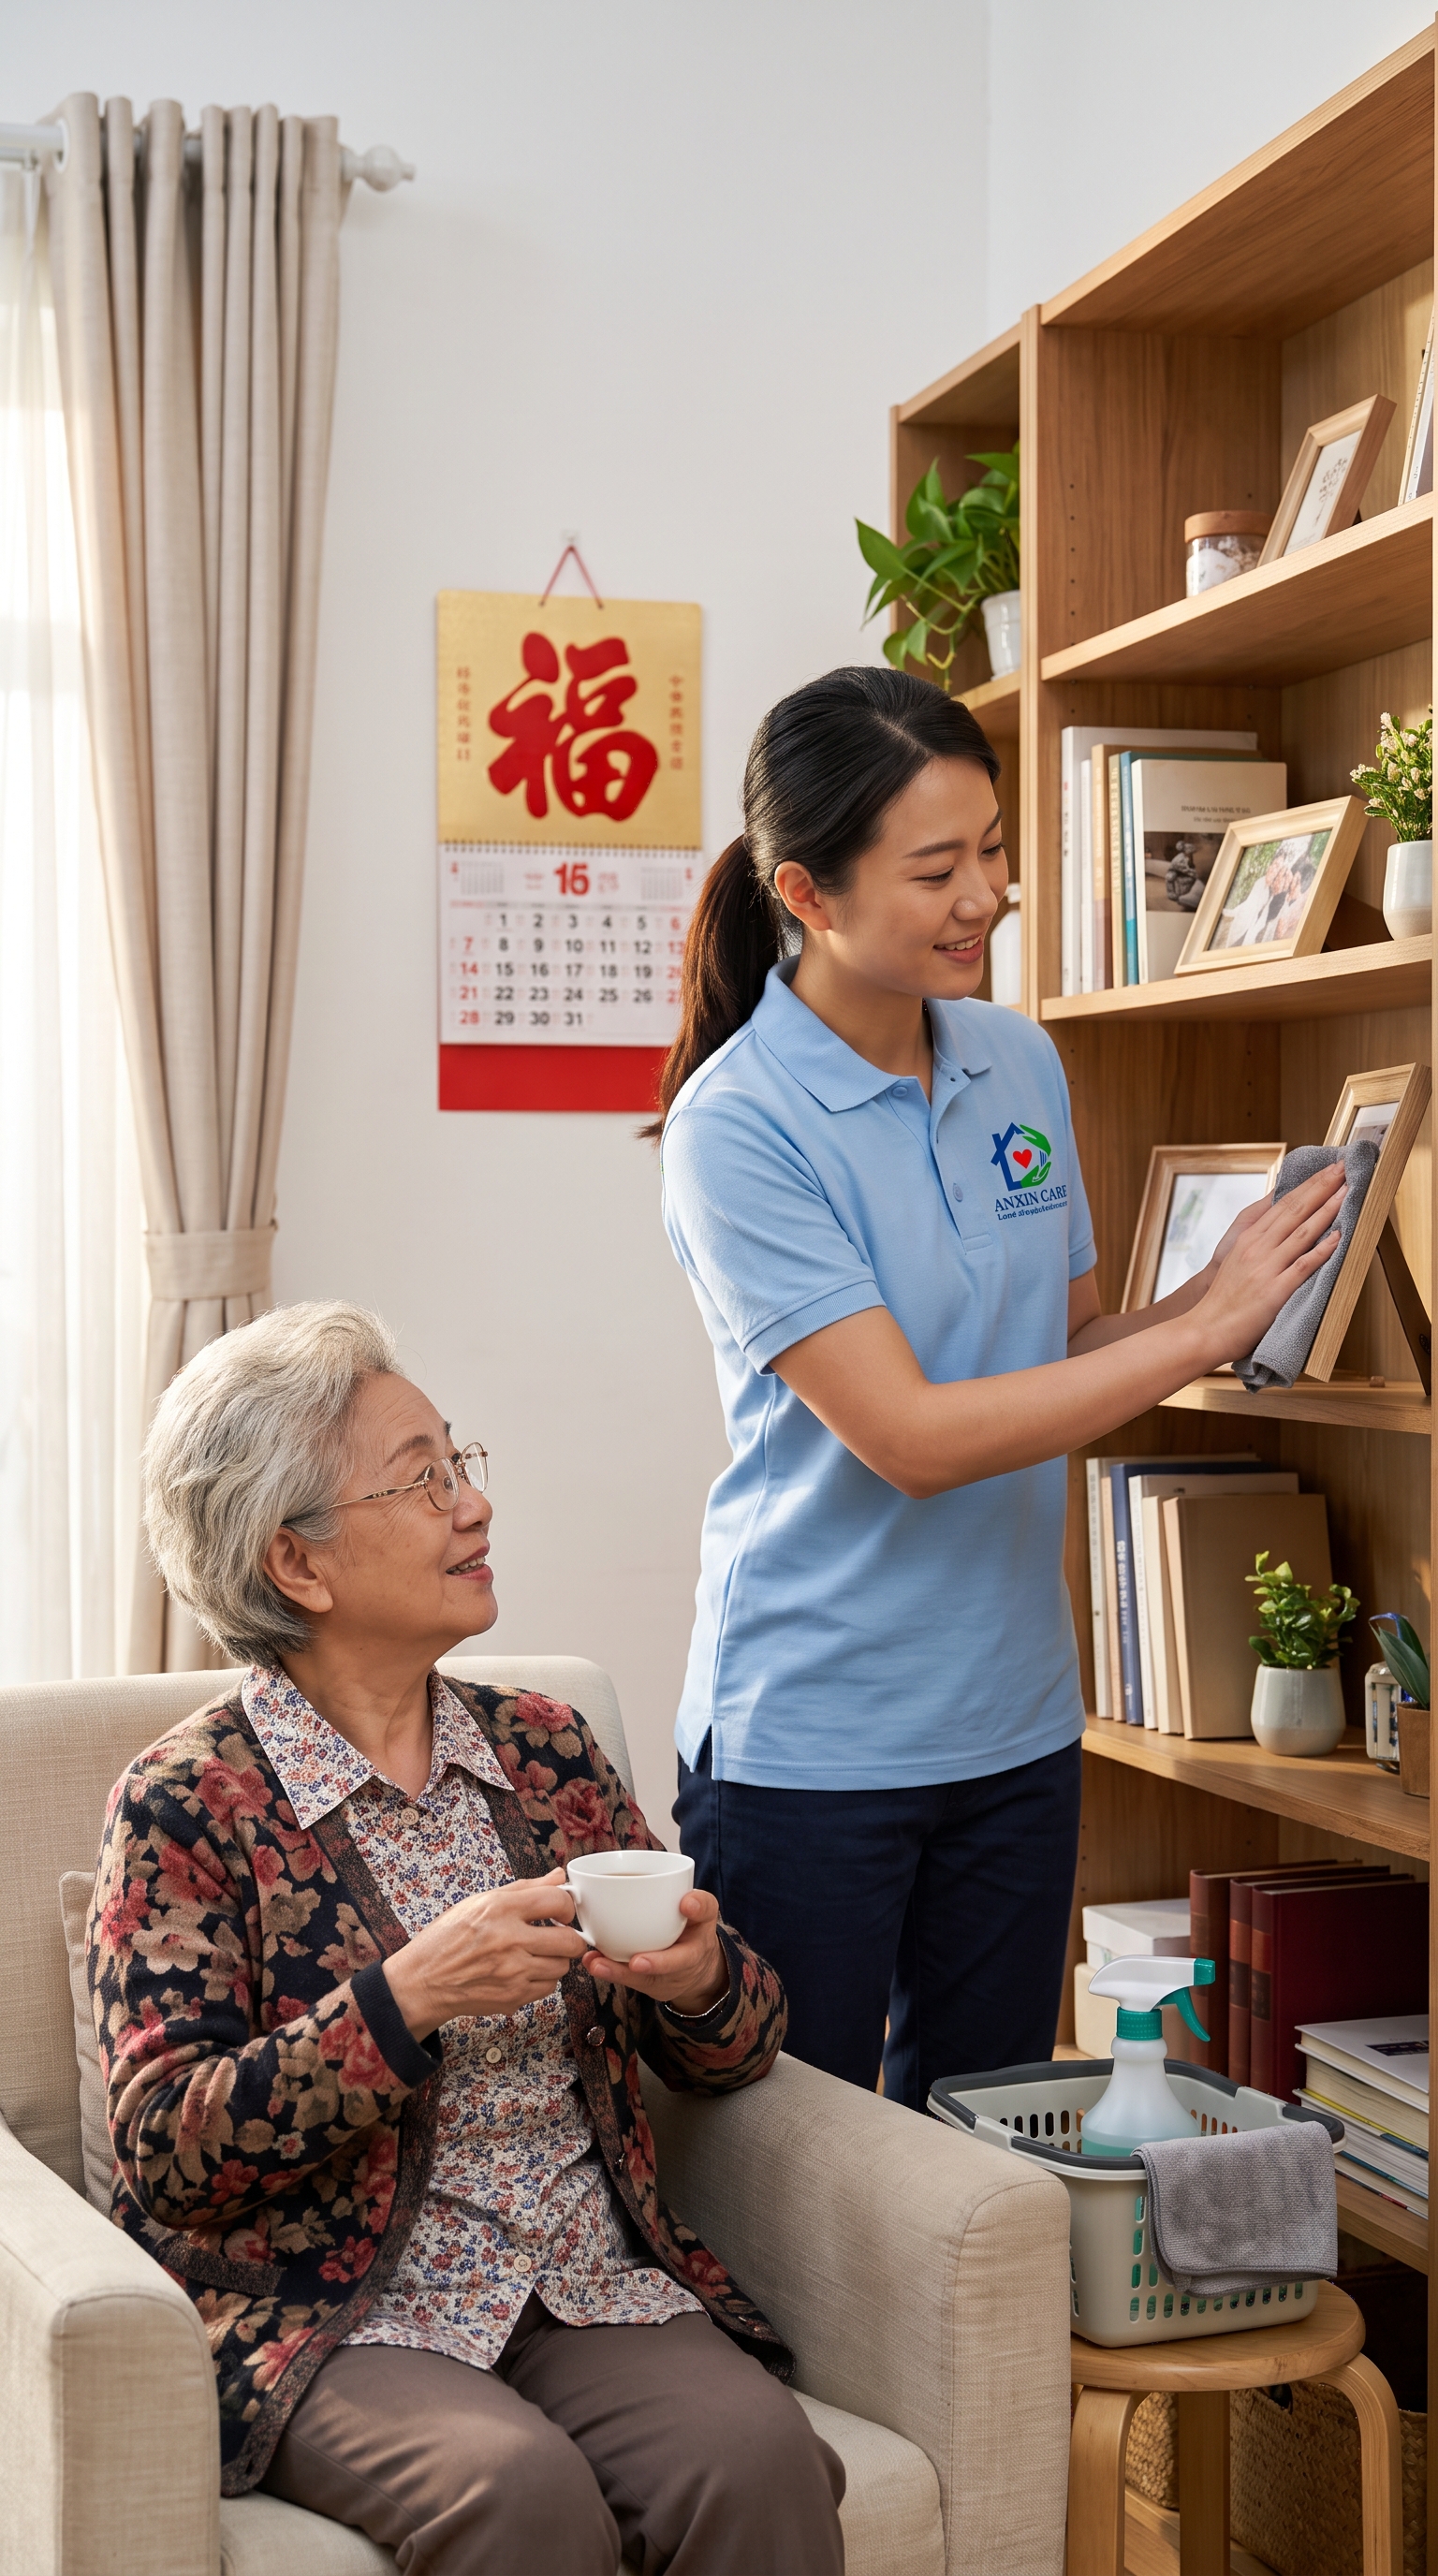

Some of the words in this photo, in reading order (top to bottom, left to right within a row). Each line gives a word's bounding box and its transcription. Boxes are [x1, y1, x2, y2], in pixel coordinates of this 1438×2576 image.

[489, 634, 658, 821] 福
[499, 913, 507, 927] 1
[534, 914, 543, 929] 2
[569, 914, 579, 929] 3
[602, 915, 613, 929] 4
[637, 915, 647, 931] 5
[670, 916, 682, 931] 6
[462, 936, 474, 952] 7
[498, 937, 509, 952] 8
[534, 937, 544, 953] 9
[565, 938, 584, 955] 10
[599, 940, 616, 953] 11
[634, 940, 652, 955] 12
[461, 961, 478, 975] 14
[495, 961, 515, 977] 15
[531, 962, 550, 977] 16
[565, 962, 584, 977] 17
[600, 963, 618, 979] 18
[635, 964, 653, 979] 19
[460, 985, 477, 1001] 21
[494, 986, 514, 1002] 22
[529, 987, 550, 1002] 23
[564, 988, 583, 1003] 24
[598, 988, 619, 1003] 25
[633, 988, 653, 1003] 26
[460, 1010, 480, 1025] 28
[494, 1010, 515, 1026] 29
[530, 1011, 551, 1027] 30
[565, 1011, 583, 1027] 31
[994, 1192, 1039, 1212] ANXIN
[1040, 1184, 1067, 1203] CARE
